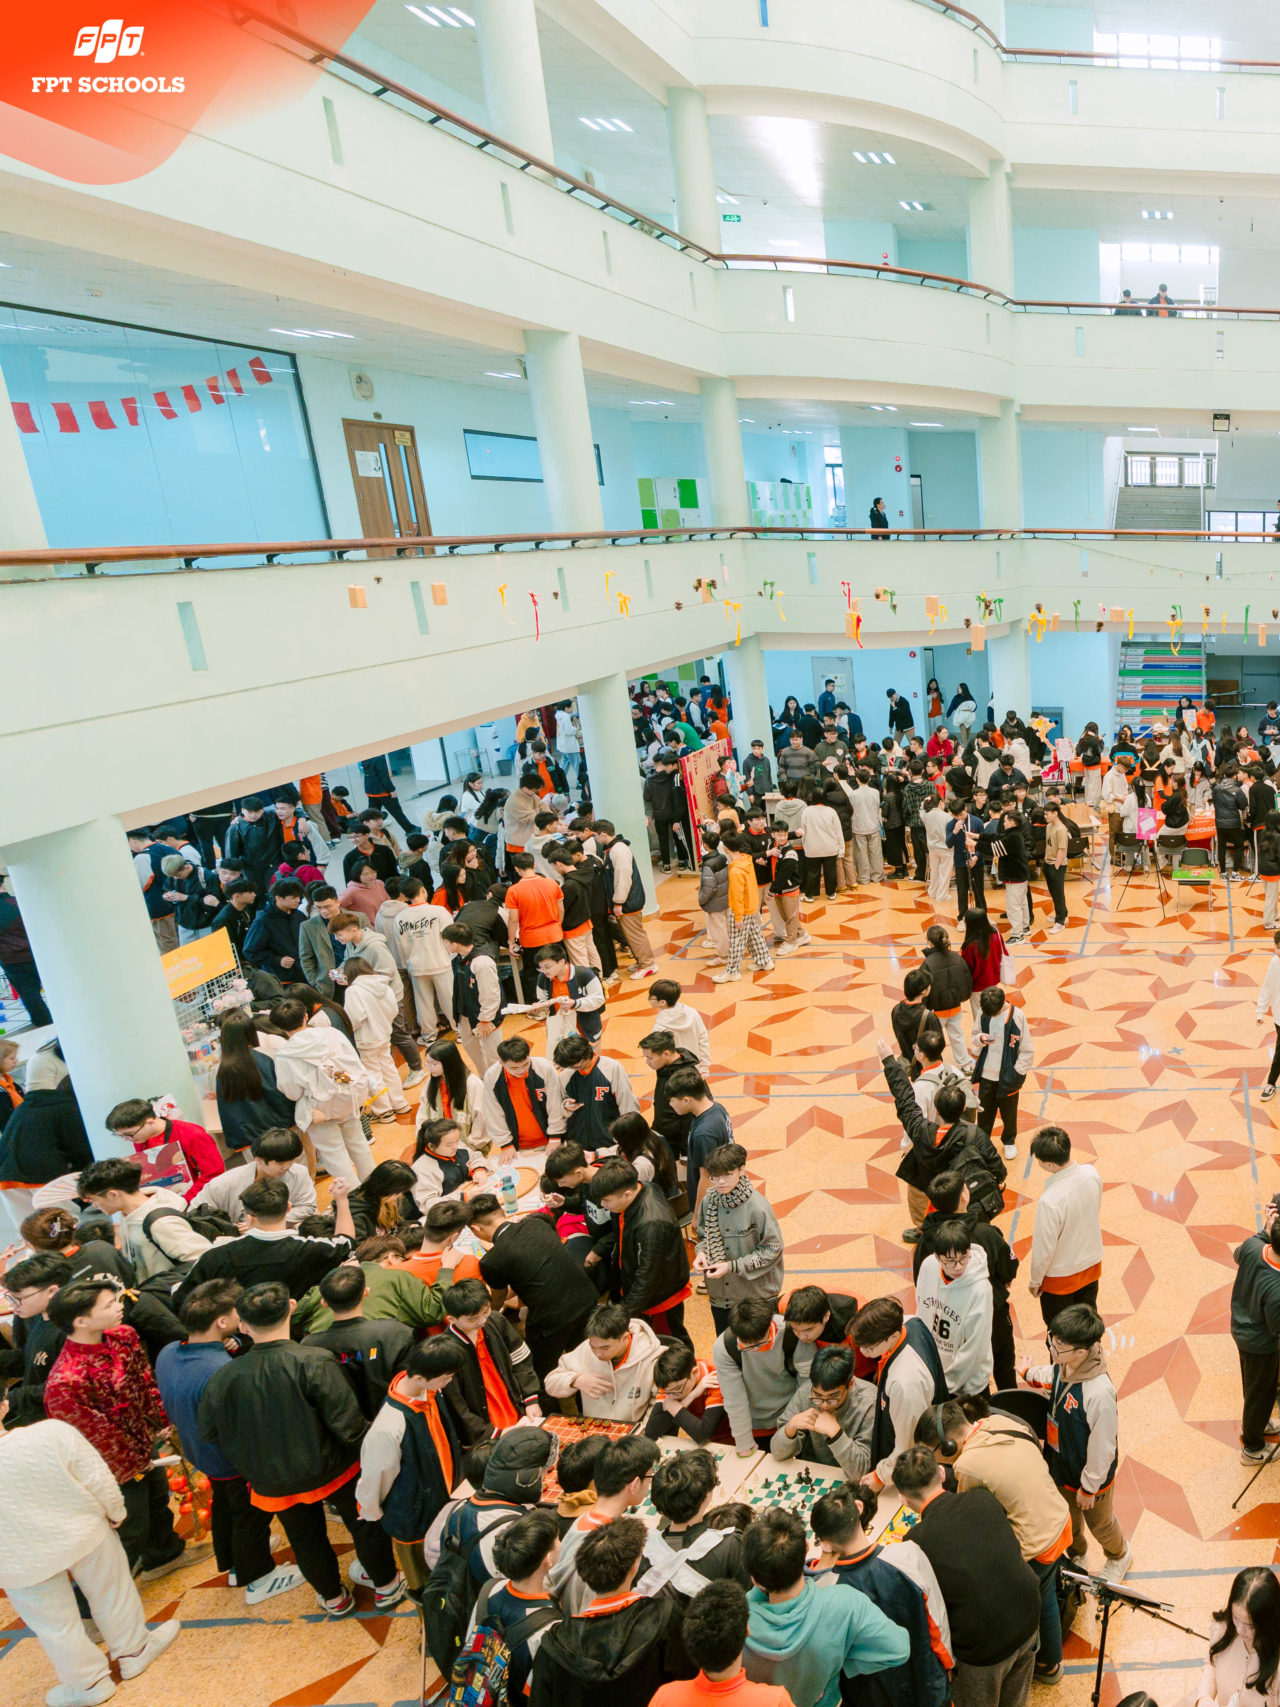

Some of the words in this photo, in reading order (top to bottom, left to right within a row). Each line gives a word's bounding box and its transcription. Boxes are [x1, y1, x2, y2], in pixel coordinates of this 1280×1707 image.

[1009, 1034, 1021, 1048] F
[535, 1088, 547, 1101] F
[595, 1086, 609, 1101] F
[1063, 1392, 1078, 1414] F
